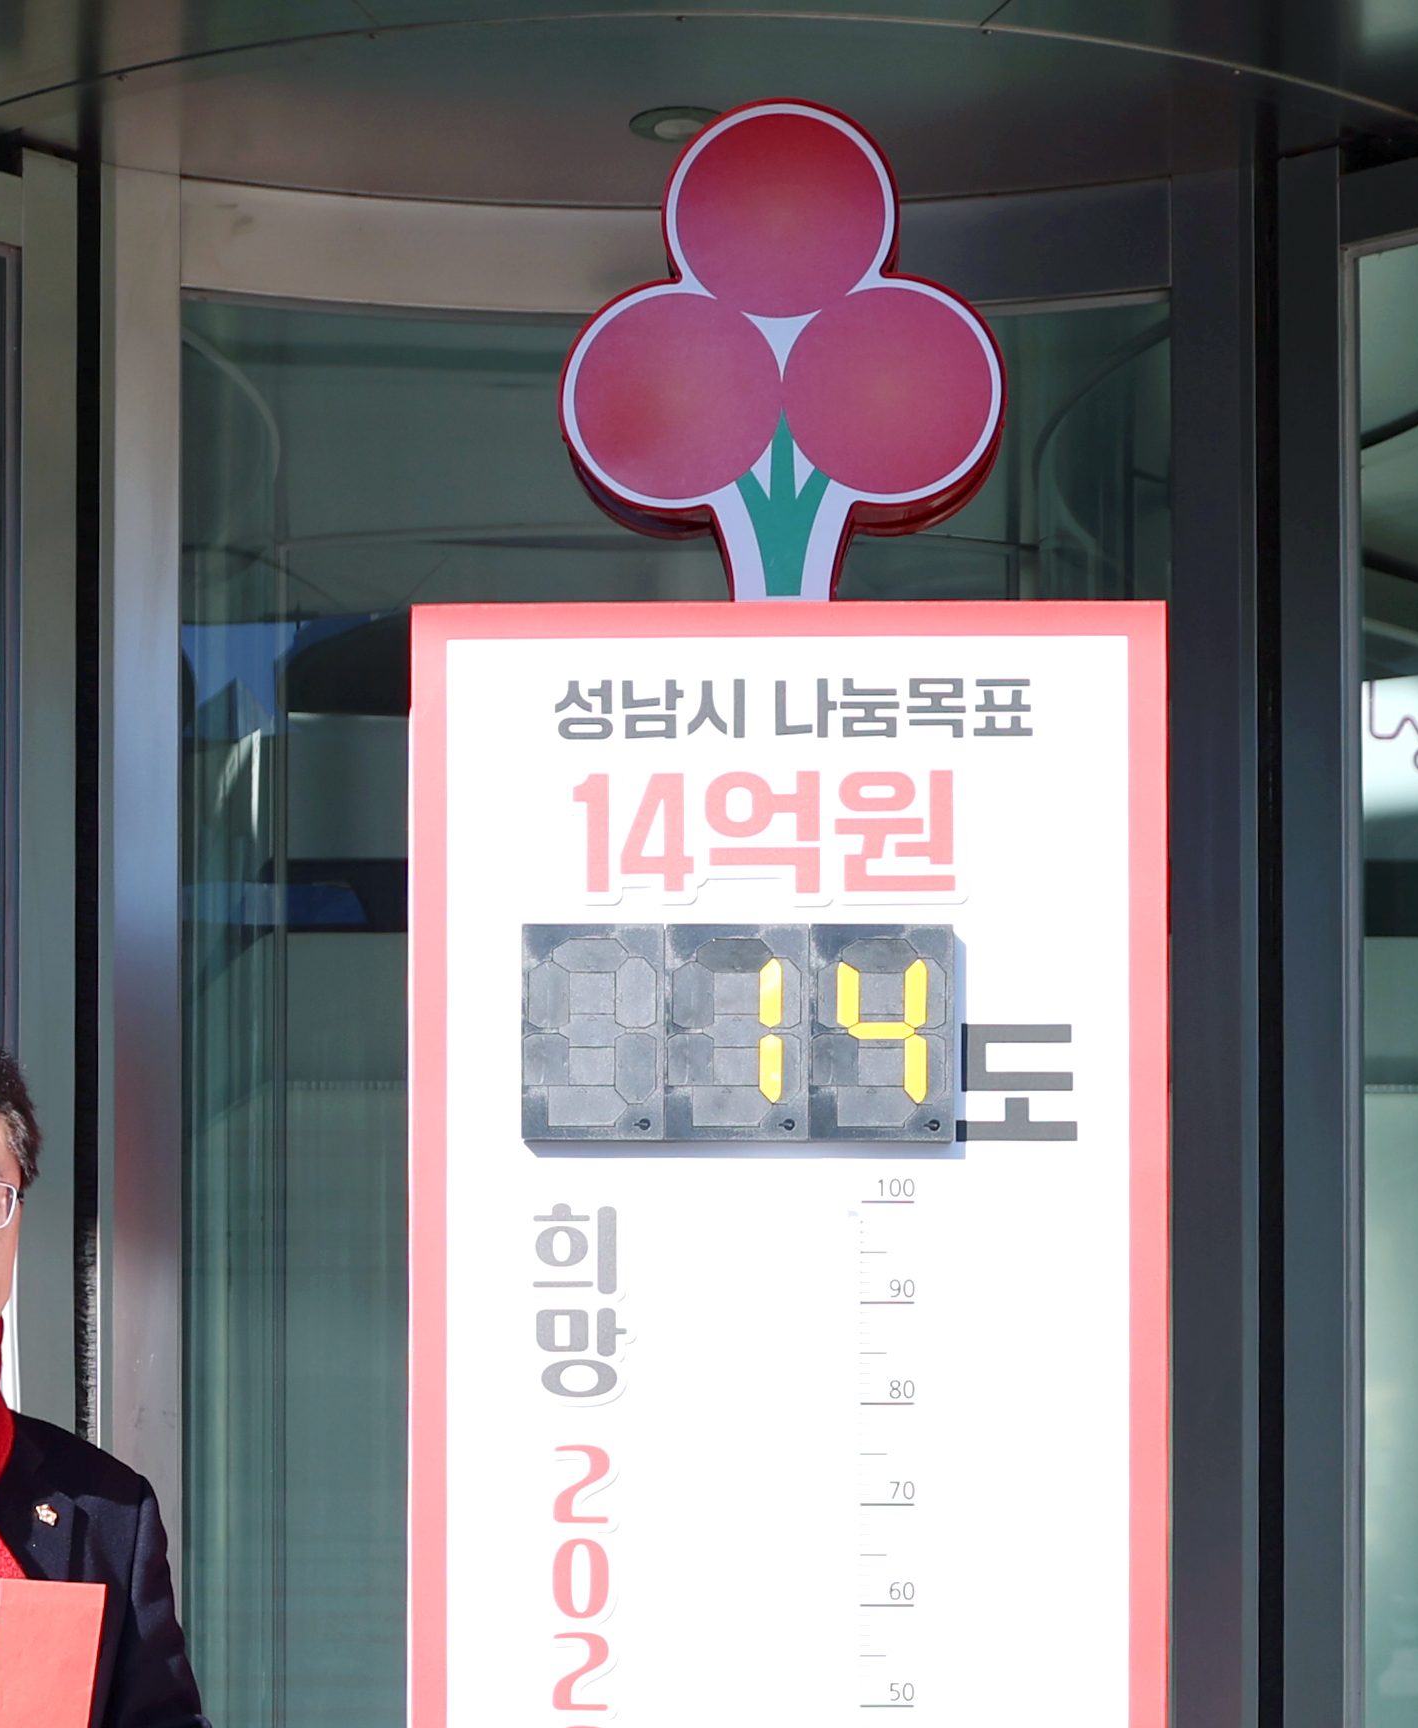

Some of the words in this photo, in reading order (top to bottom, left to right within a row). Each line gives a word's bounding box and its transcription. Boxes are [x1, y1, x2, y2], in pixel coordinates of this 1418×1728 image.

[554, 678, 746, 740] 성남시
[774, 677, 1034, 739] 나눔목표
[572, 769, 957, 894] 14억원
[757, 957, 928, 1105] 14
[956, 1023, 1079, 1142] 도
[877, 1178, 915, 1198] 100
[888, 1279, 915, 1298] 90
[533, 1203, 627, 1398] 희망
[888, 1380, 915, 1399] 80
[888, 1481, 915, 1500] 70
[888, 1581, 915, 1601] 60
[888, 1682, 915, 1701] 50
